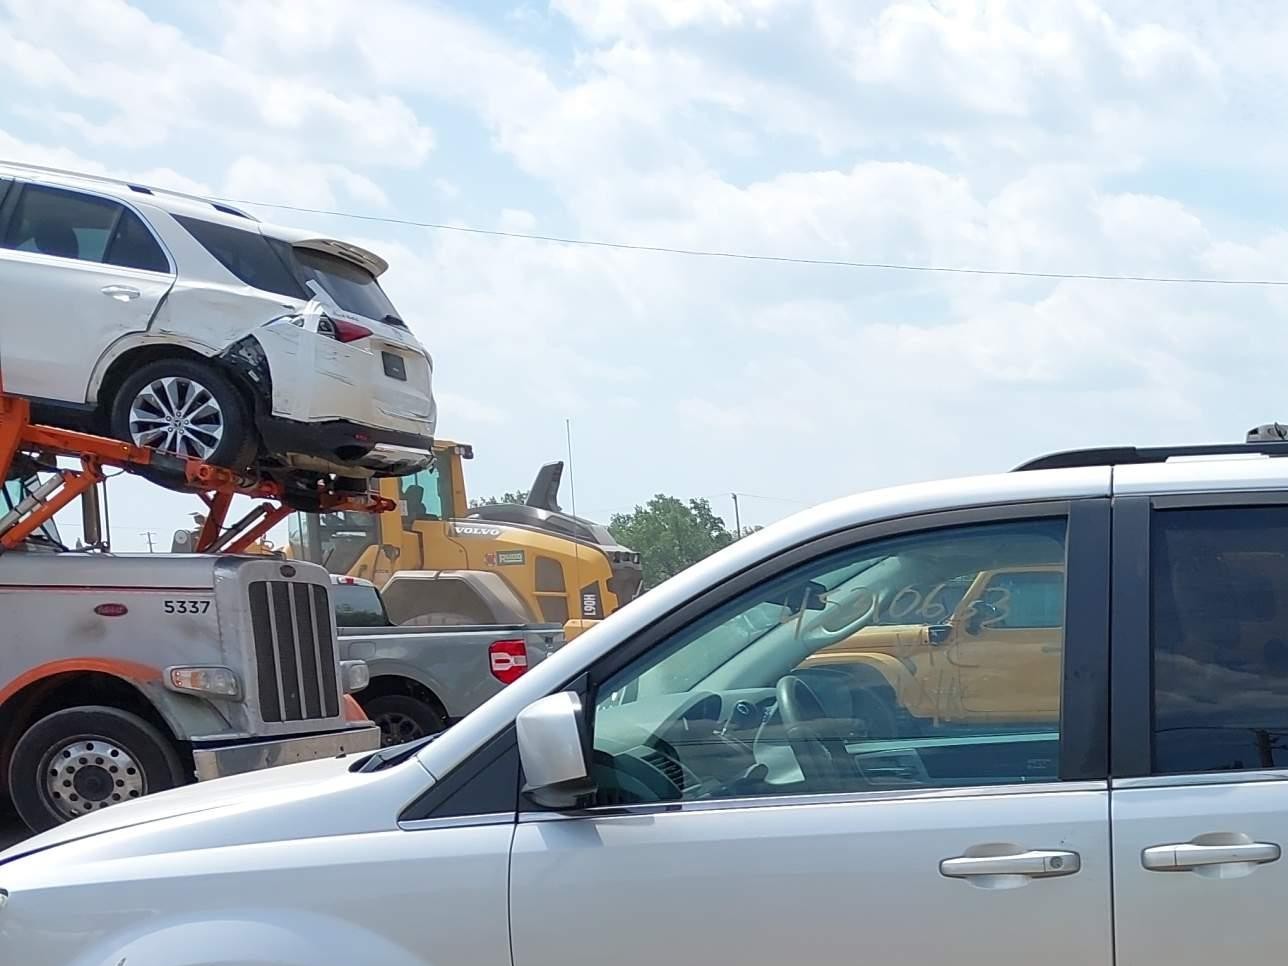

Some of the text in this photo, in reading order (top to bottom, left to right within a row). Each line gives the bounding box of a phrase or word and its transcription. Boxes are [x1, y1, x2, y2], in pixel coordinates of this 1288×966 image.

[455, 527, 500, 536] VOLVO
[164, 600, 211, 614] 5337
[583, 594, 597, 616] L90H
